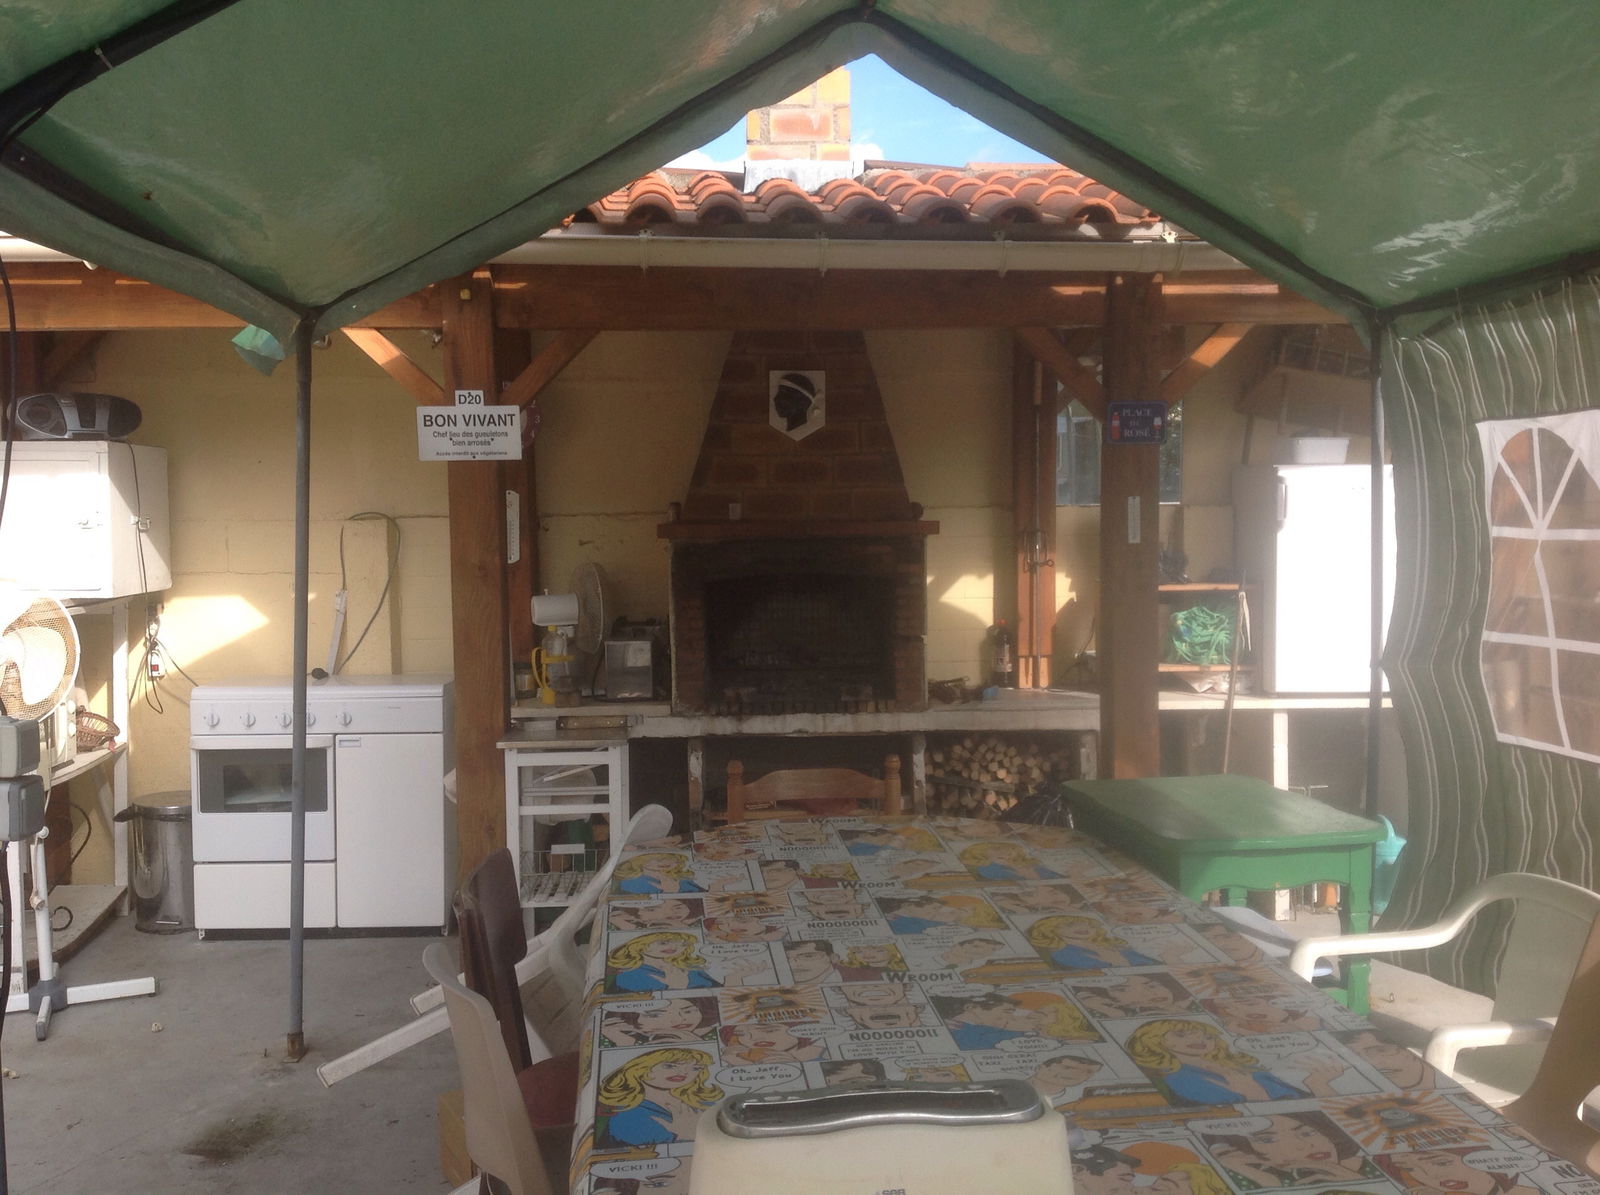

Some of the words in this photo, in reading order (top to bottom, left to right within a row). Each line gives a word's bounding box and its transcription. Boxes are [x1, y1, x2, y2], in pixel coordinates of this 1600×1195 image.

[458, 394, 481, 405] D20
[423, 414, 457, 427] BON
[462, 413, 516, 427] VIVANT
[842, 880, 896, 889] WROOM
[887, 972, 953, 983] WROOM
[609, 1164, 643, 1173] VICKI
